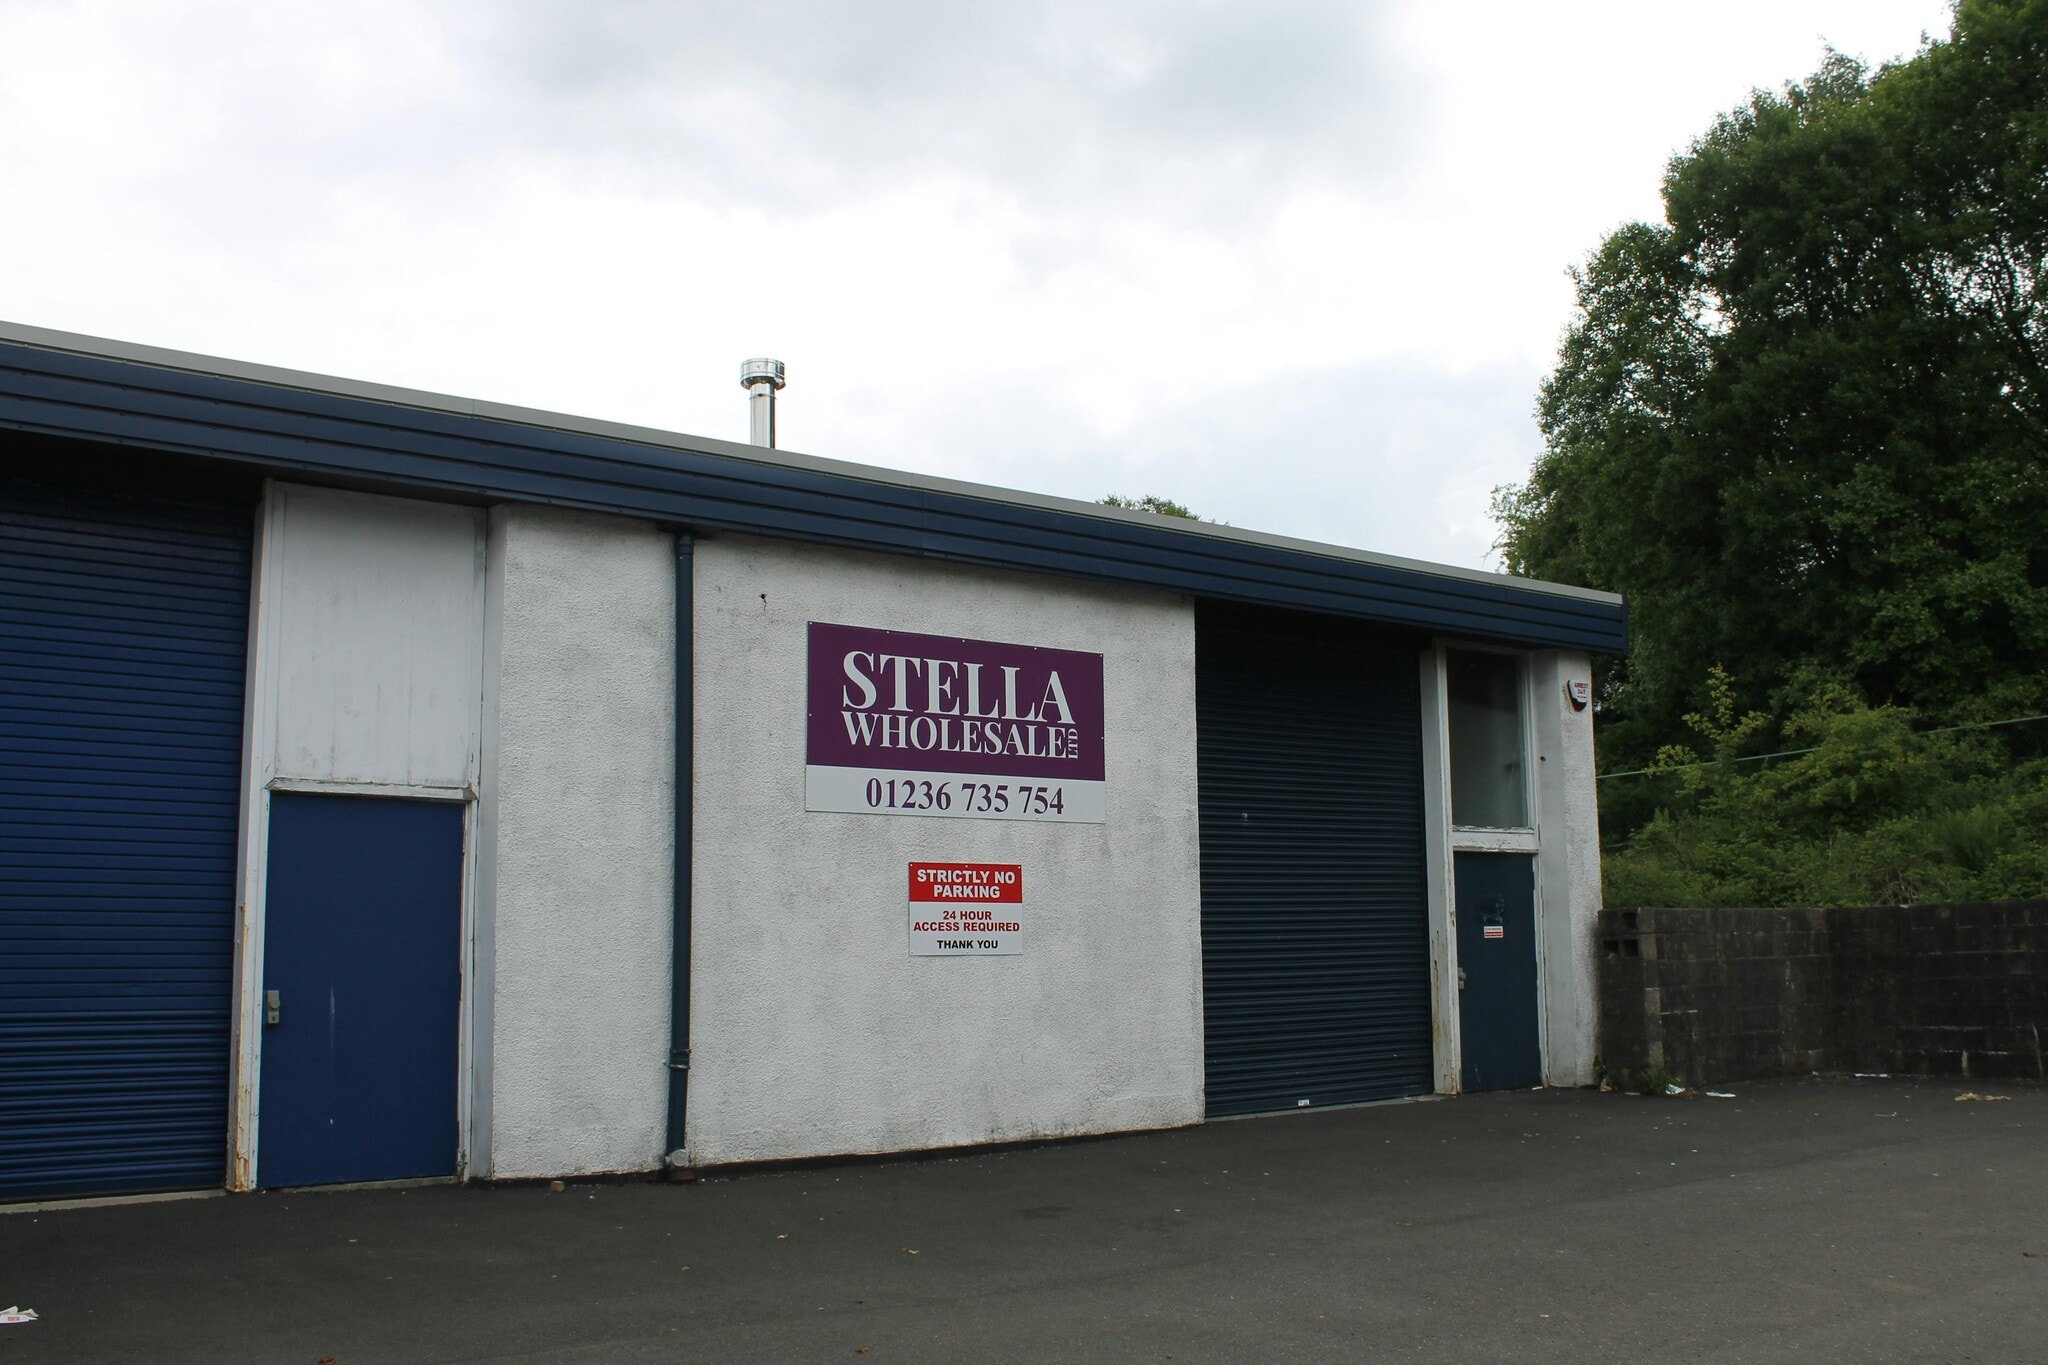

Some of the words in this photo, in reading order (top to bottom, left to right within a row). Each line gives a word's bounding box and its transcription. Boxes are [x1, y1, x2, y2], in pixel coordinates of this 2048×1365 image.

[842, 650, 1076, 725] STELLA
[841, 710, 1067, 759] WHOLESALE
[1067, 728, 1079, 760] LTD
[866, 777, 952, 811] 01236
[961, 783, 1009, 813] 735
[1018, 786, 1064, 815] 754
[917, 868, 990, 883] STRICTLY
[994, 871, 1016, 885] NO
[933, 884, 1001, 899] PARKING
[942, 910, 957, 921] 24
[959, 910, 992, 921] HOUR
[913, 921, 960, 932] ACCESS
[963, 922, 1020, 932] REQUIRED
[936, 939, 974, 949] THANK
[977, 939, 999, 949] YOU
